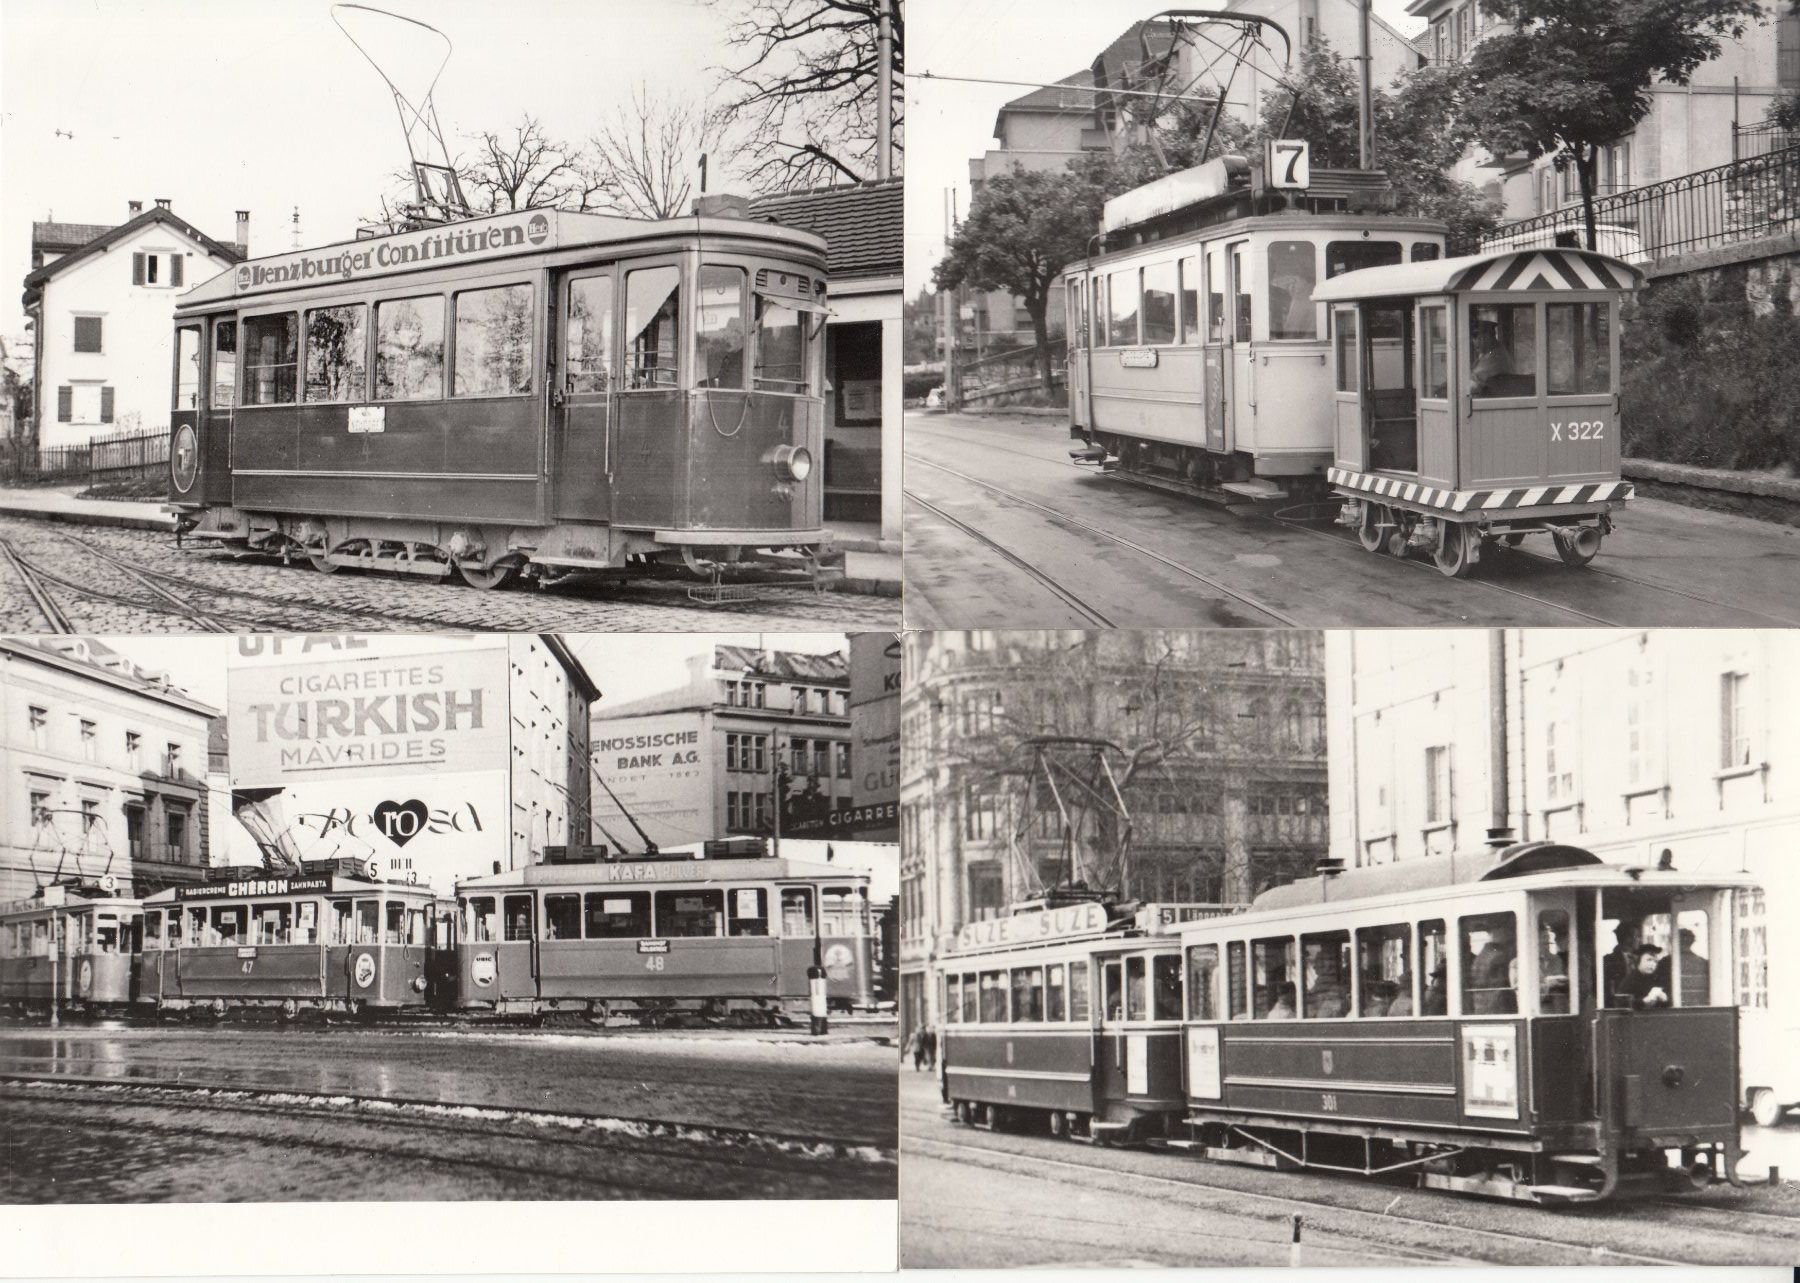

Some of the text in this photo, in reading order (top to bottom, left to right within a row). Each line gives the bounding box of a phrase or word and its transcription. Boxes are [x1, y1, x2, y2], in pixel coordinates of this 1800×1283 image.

[698, 153, 707, 193] 1
[1276, 145, 1304, 183] 7
[252, 224, 525, 279] Lenzburger Confitüren
[777, 410, 789, 439] 4
[1551, 421, 1604, 441] X 322
[279, 665, 445, 695] CIGARETTES
[248, 688, 484, 743] TURKISH
[281, 738, 446, 766] MAVRIDES
[617, 750, 701, 769] BANK A.G.
[370, 862, 377, 878] 5
[608, 864, 657, 881] KAFA
[105, 876, 114, 889] 3
[228, 880, 288, 896] CHÉRON
[963, 905, 1098, 946] SUZE SUZE
[1162, 909, 1173, 924] 5
[242, 961, 254, 974] 47
[645, 955, 664, 971] 48
[1321, 1094, 1338, 1111] 301
